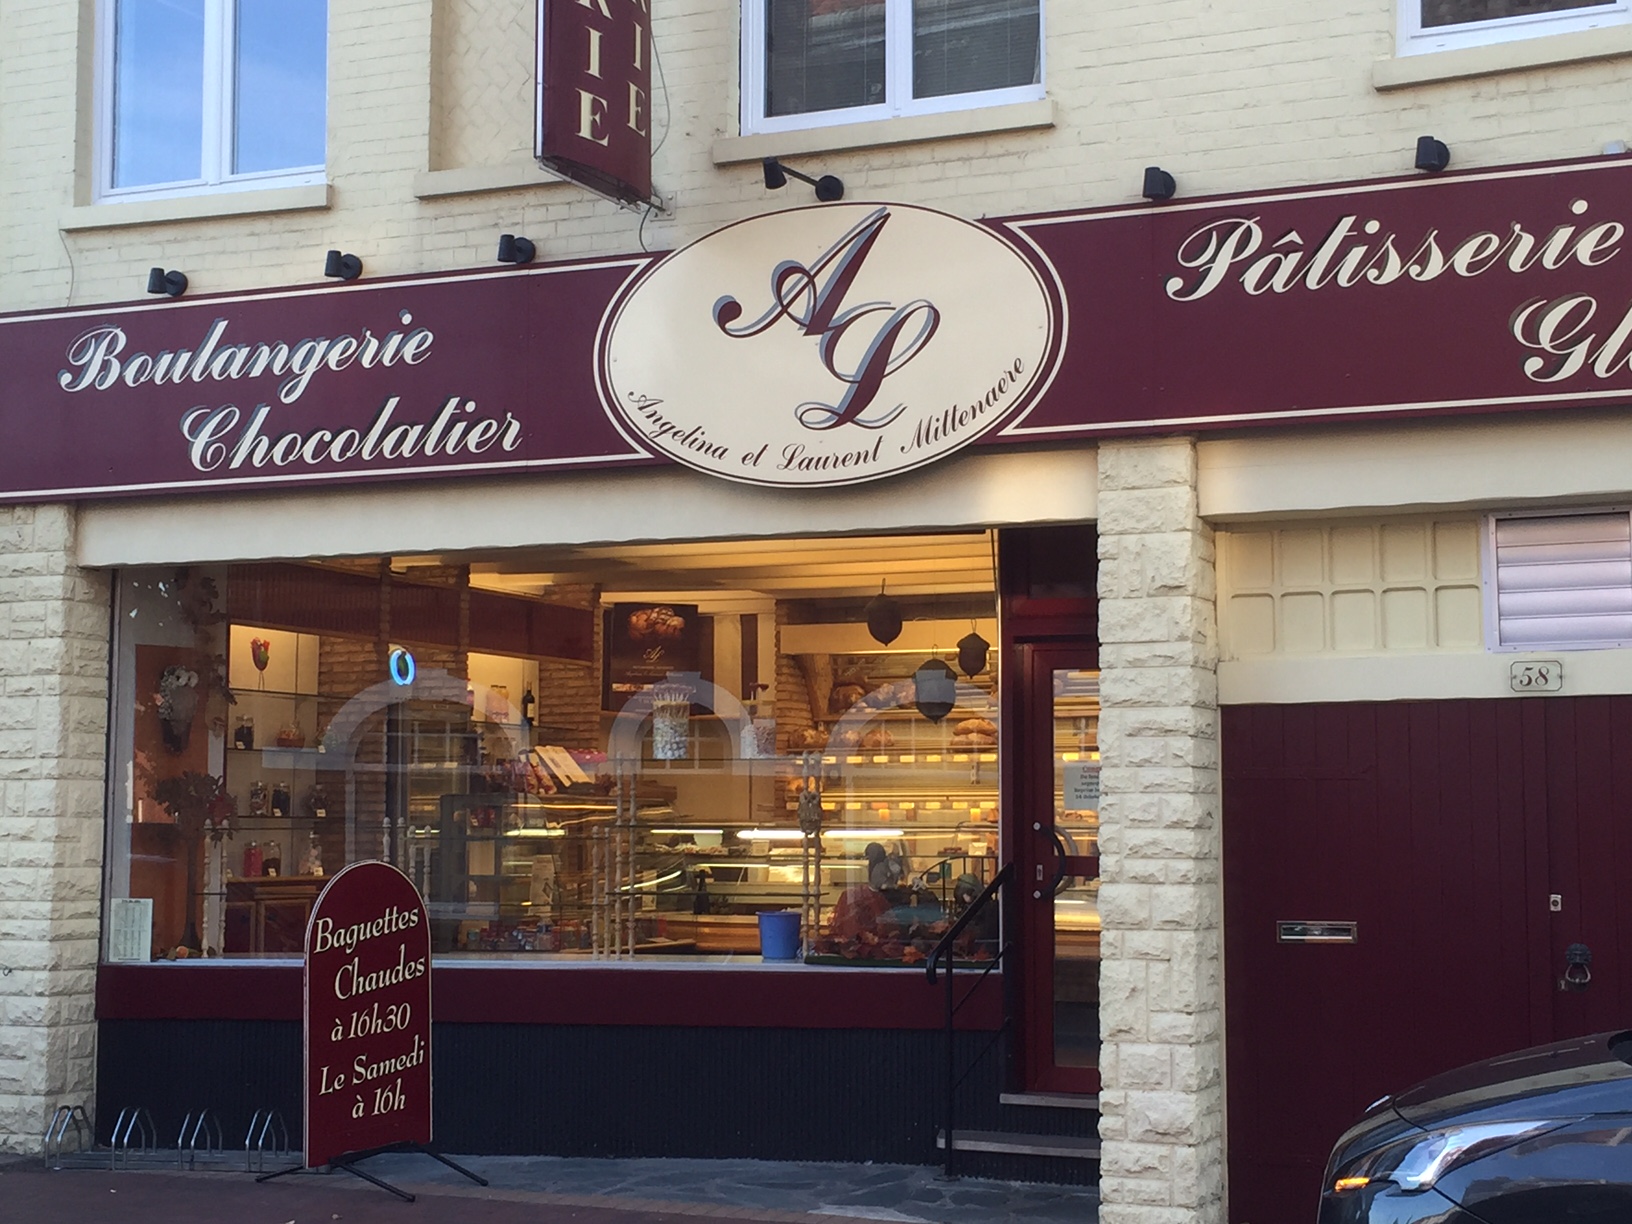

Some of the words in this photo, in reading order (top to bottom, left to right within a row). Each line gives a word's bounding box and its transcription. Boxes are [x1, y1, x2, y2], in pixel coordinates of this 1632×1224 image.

[574, 0, 614, 147] IE
[626, 0, 647, 137] IE
[1164, 199, 1625, 302] Pâtisserie
[58, 311, 434, 404] Boulangerie
[1509, 293, 1632, 383] Gl
[180, 395, 524, 472] Chocolatier
[627, 390, 729, 461] Angelina
[741, 443, 768, 468] et
[776, 435, 882, 472] Laurent
[899, 357, 1026, 454] Mittenaere
[1519, 665, 1550, 687] 58
[313, 905, 420, 955] Baguettes
[334, 943, 426, 1000] Chaudes
[330, 1018, 344, 1042] à
[347, 1001, 411, 1040] 16h30
[318, 1065, 345, 1096] Le
[351, 1033, 426, 1086] Samedi
[351, 1094, 365, 1119] à
[371, 1078, 407, 1117] 16h
